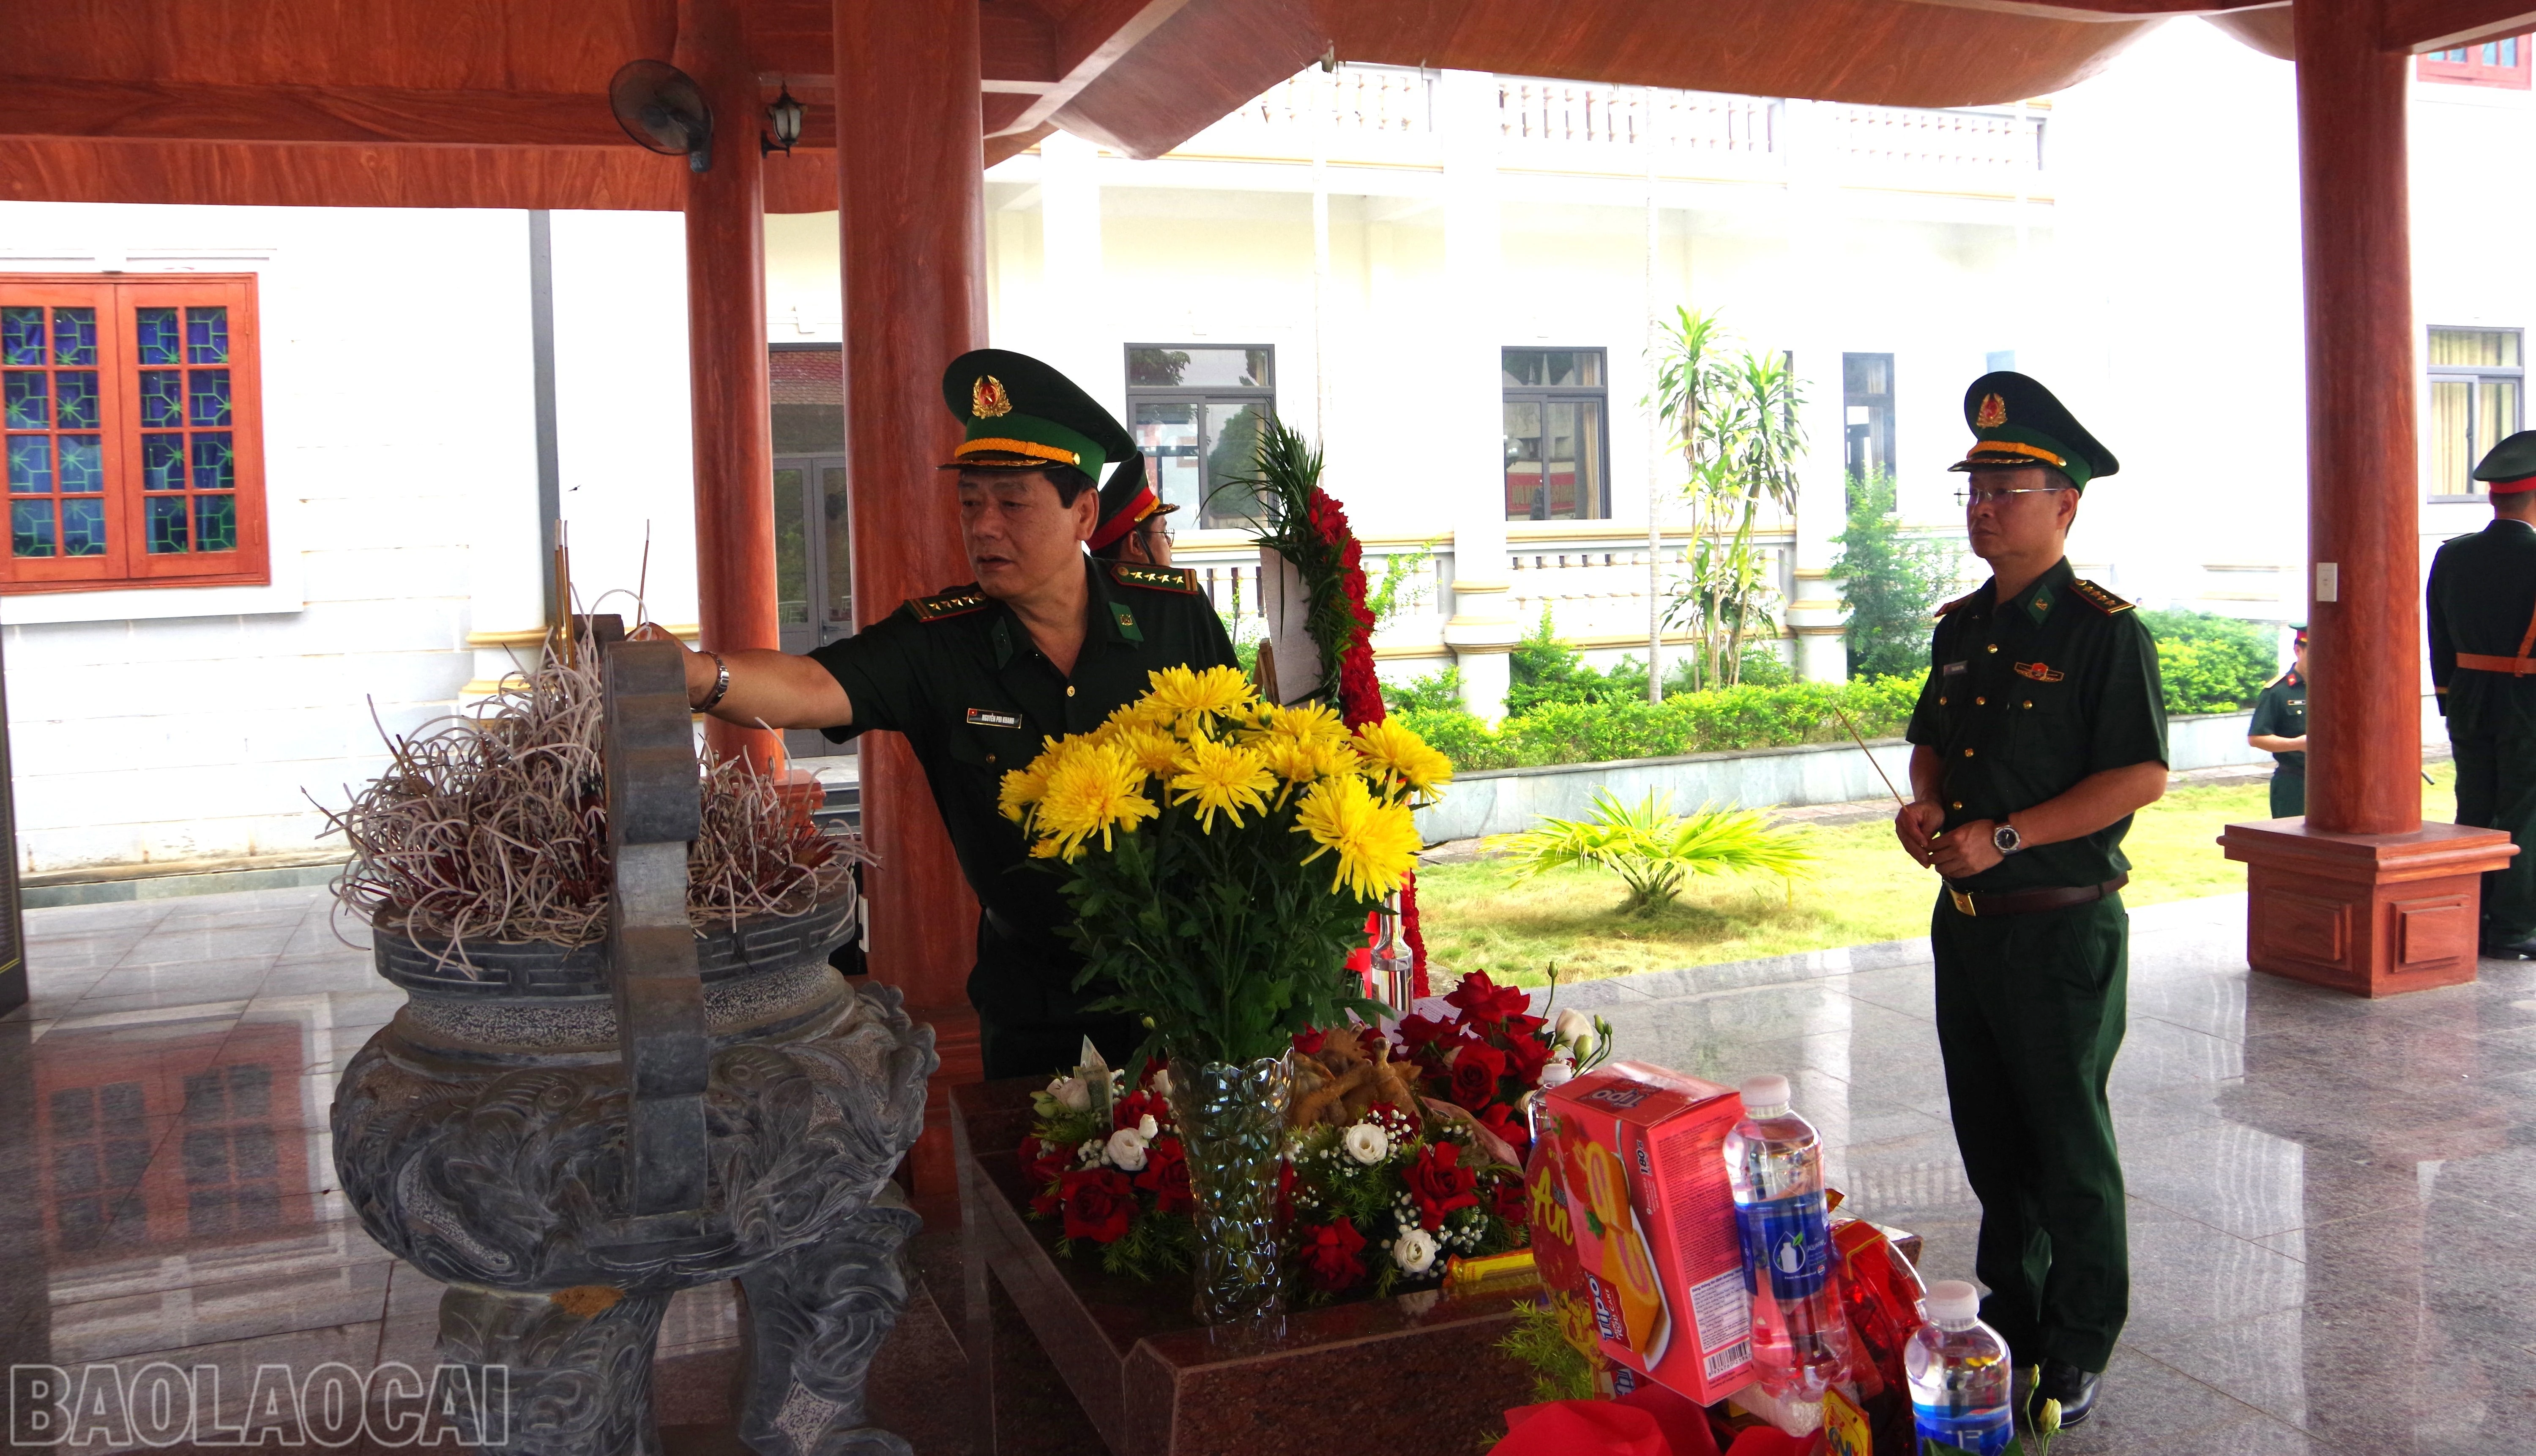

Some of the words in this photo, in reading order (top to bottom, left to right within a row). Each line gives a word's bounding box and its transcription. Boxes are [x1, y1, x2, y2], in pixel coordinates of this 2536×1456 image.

[1590, 1088, 1648, 1108] Tipo
[1637, 1149, 1648, 1175] 180
[1588, 1275, 1614, 1342] Tipo
[1605, 1288, 1614, 1311] CAKE
